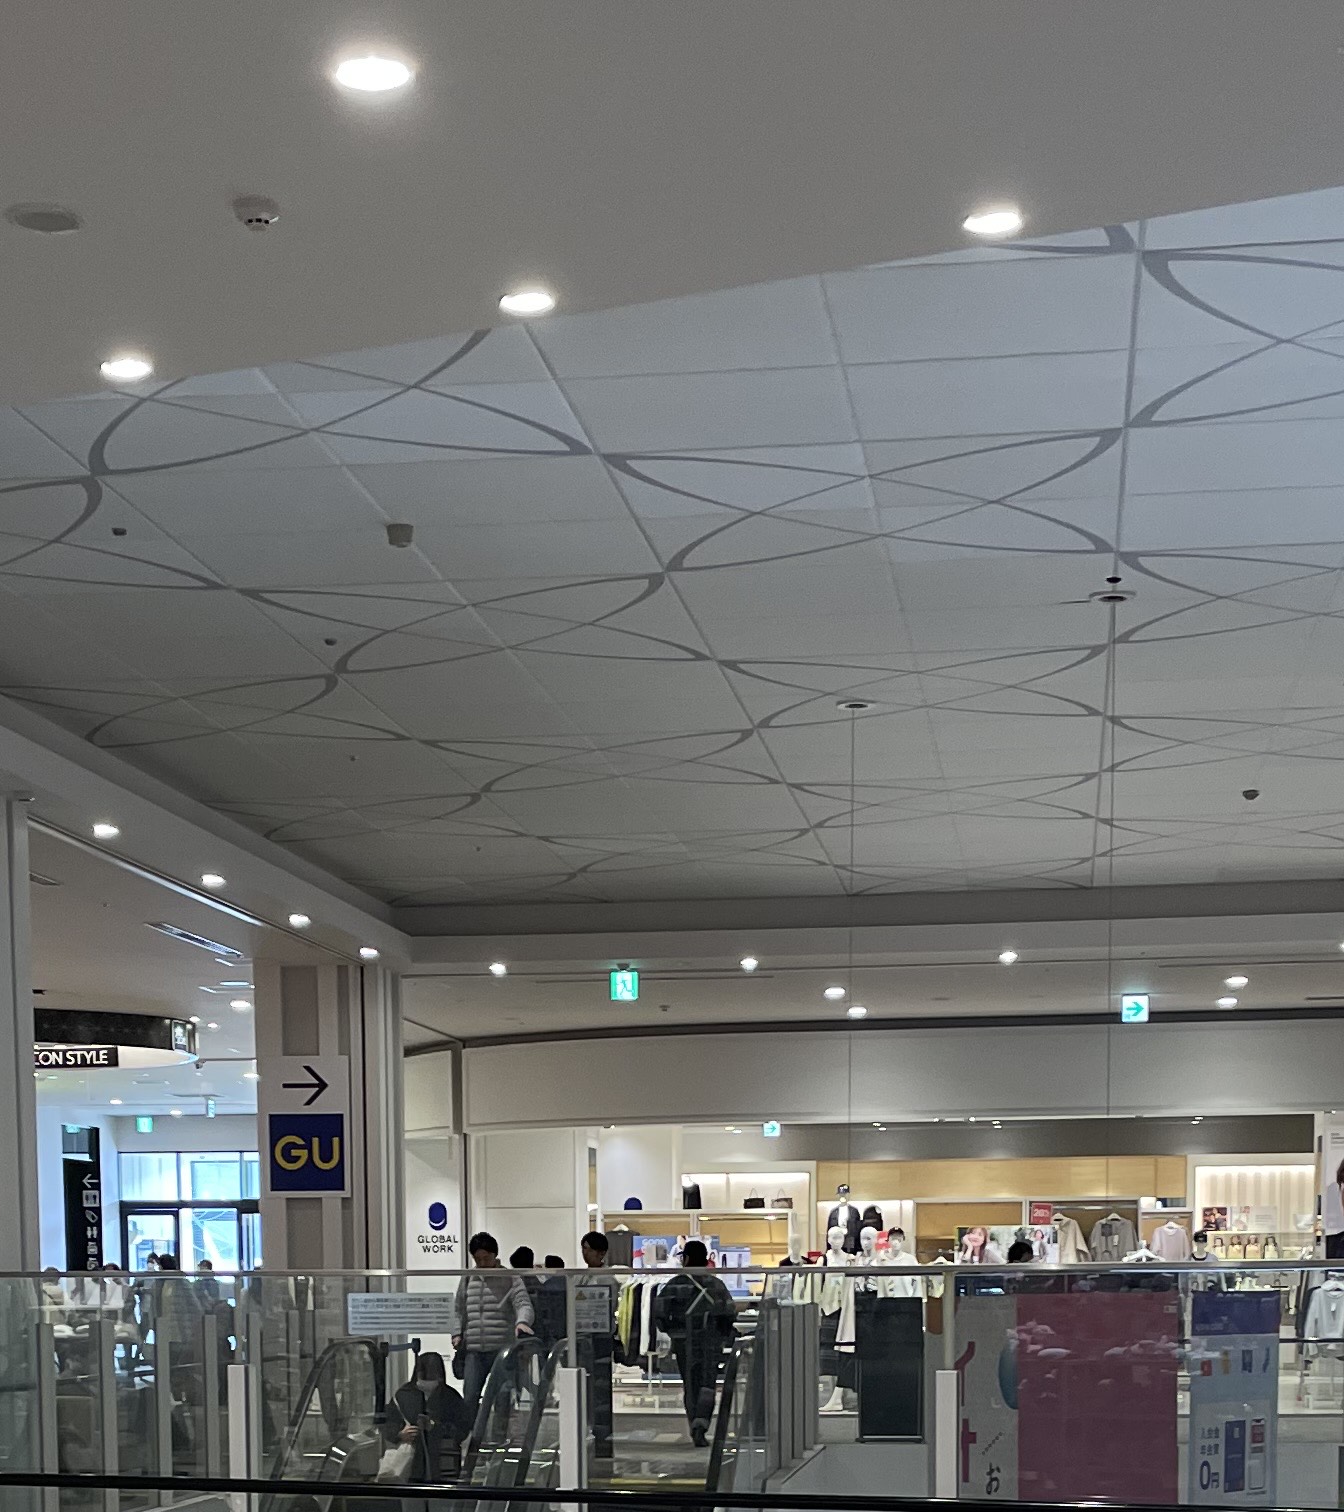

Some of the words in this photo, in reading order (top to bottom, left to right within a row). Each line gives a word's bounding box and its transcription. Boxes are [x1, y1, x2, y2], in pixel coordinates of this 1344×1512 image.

[66, 1050, 108, 1065] STYLE
[274, 1135, 340, 1171] GU
[417, 1235, 458, 1244] GLOBAL
[422, 1245, 453, 1253] WORK
[1199, 1460, 1219, 1490] 0円
